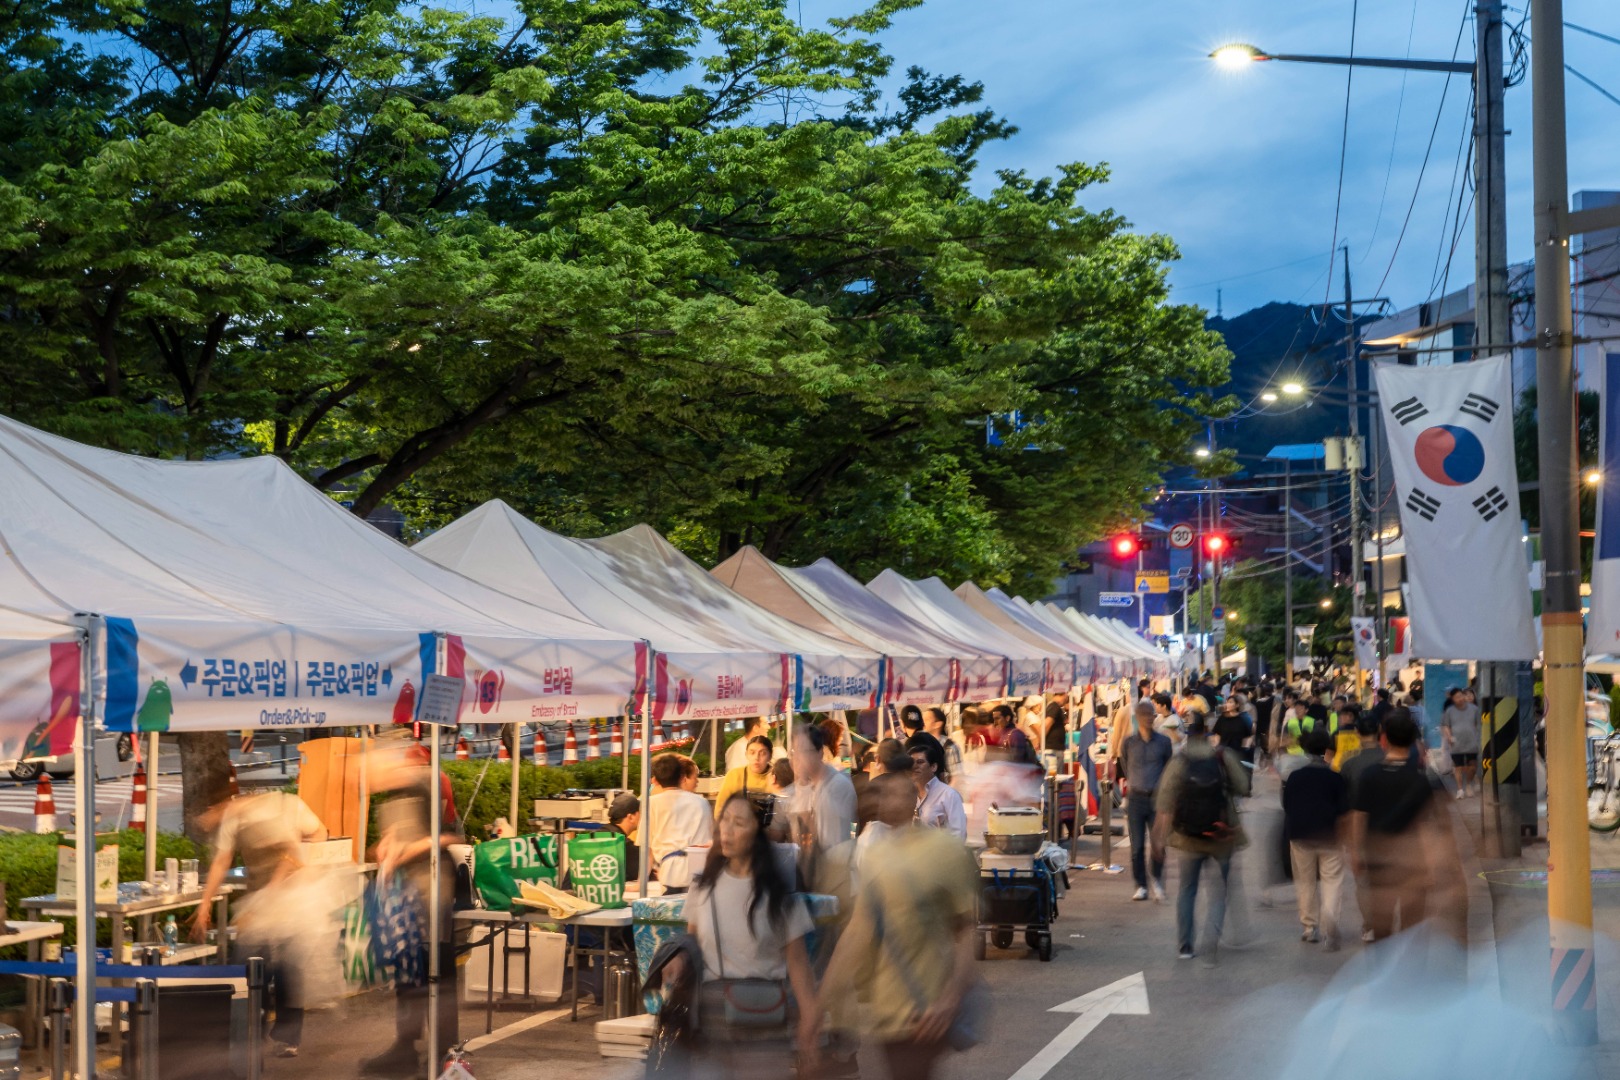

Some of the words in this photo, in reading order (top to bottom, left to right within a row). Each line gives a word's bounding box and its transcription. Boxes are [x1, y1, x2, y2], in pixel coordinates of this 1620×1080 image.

[1174, 531, 1189, 542] 30
[202, 658, 286, 697] 주문&픽업
[306, 661, 379, 697] 주문&픽업
[543, 666, 573, 694] 브라질
[482, 681, 496, 703] 43
[260, 707, 326, 726] Order&Pick-up
[531, 704, 555, 719] Embassy
[573, 883, 620, 903] ARTH
